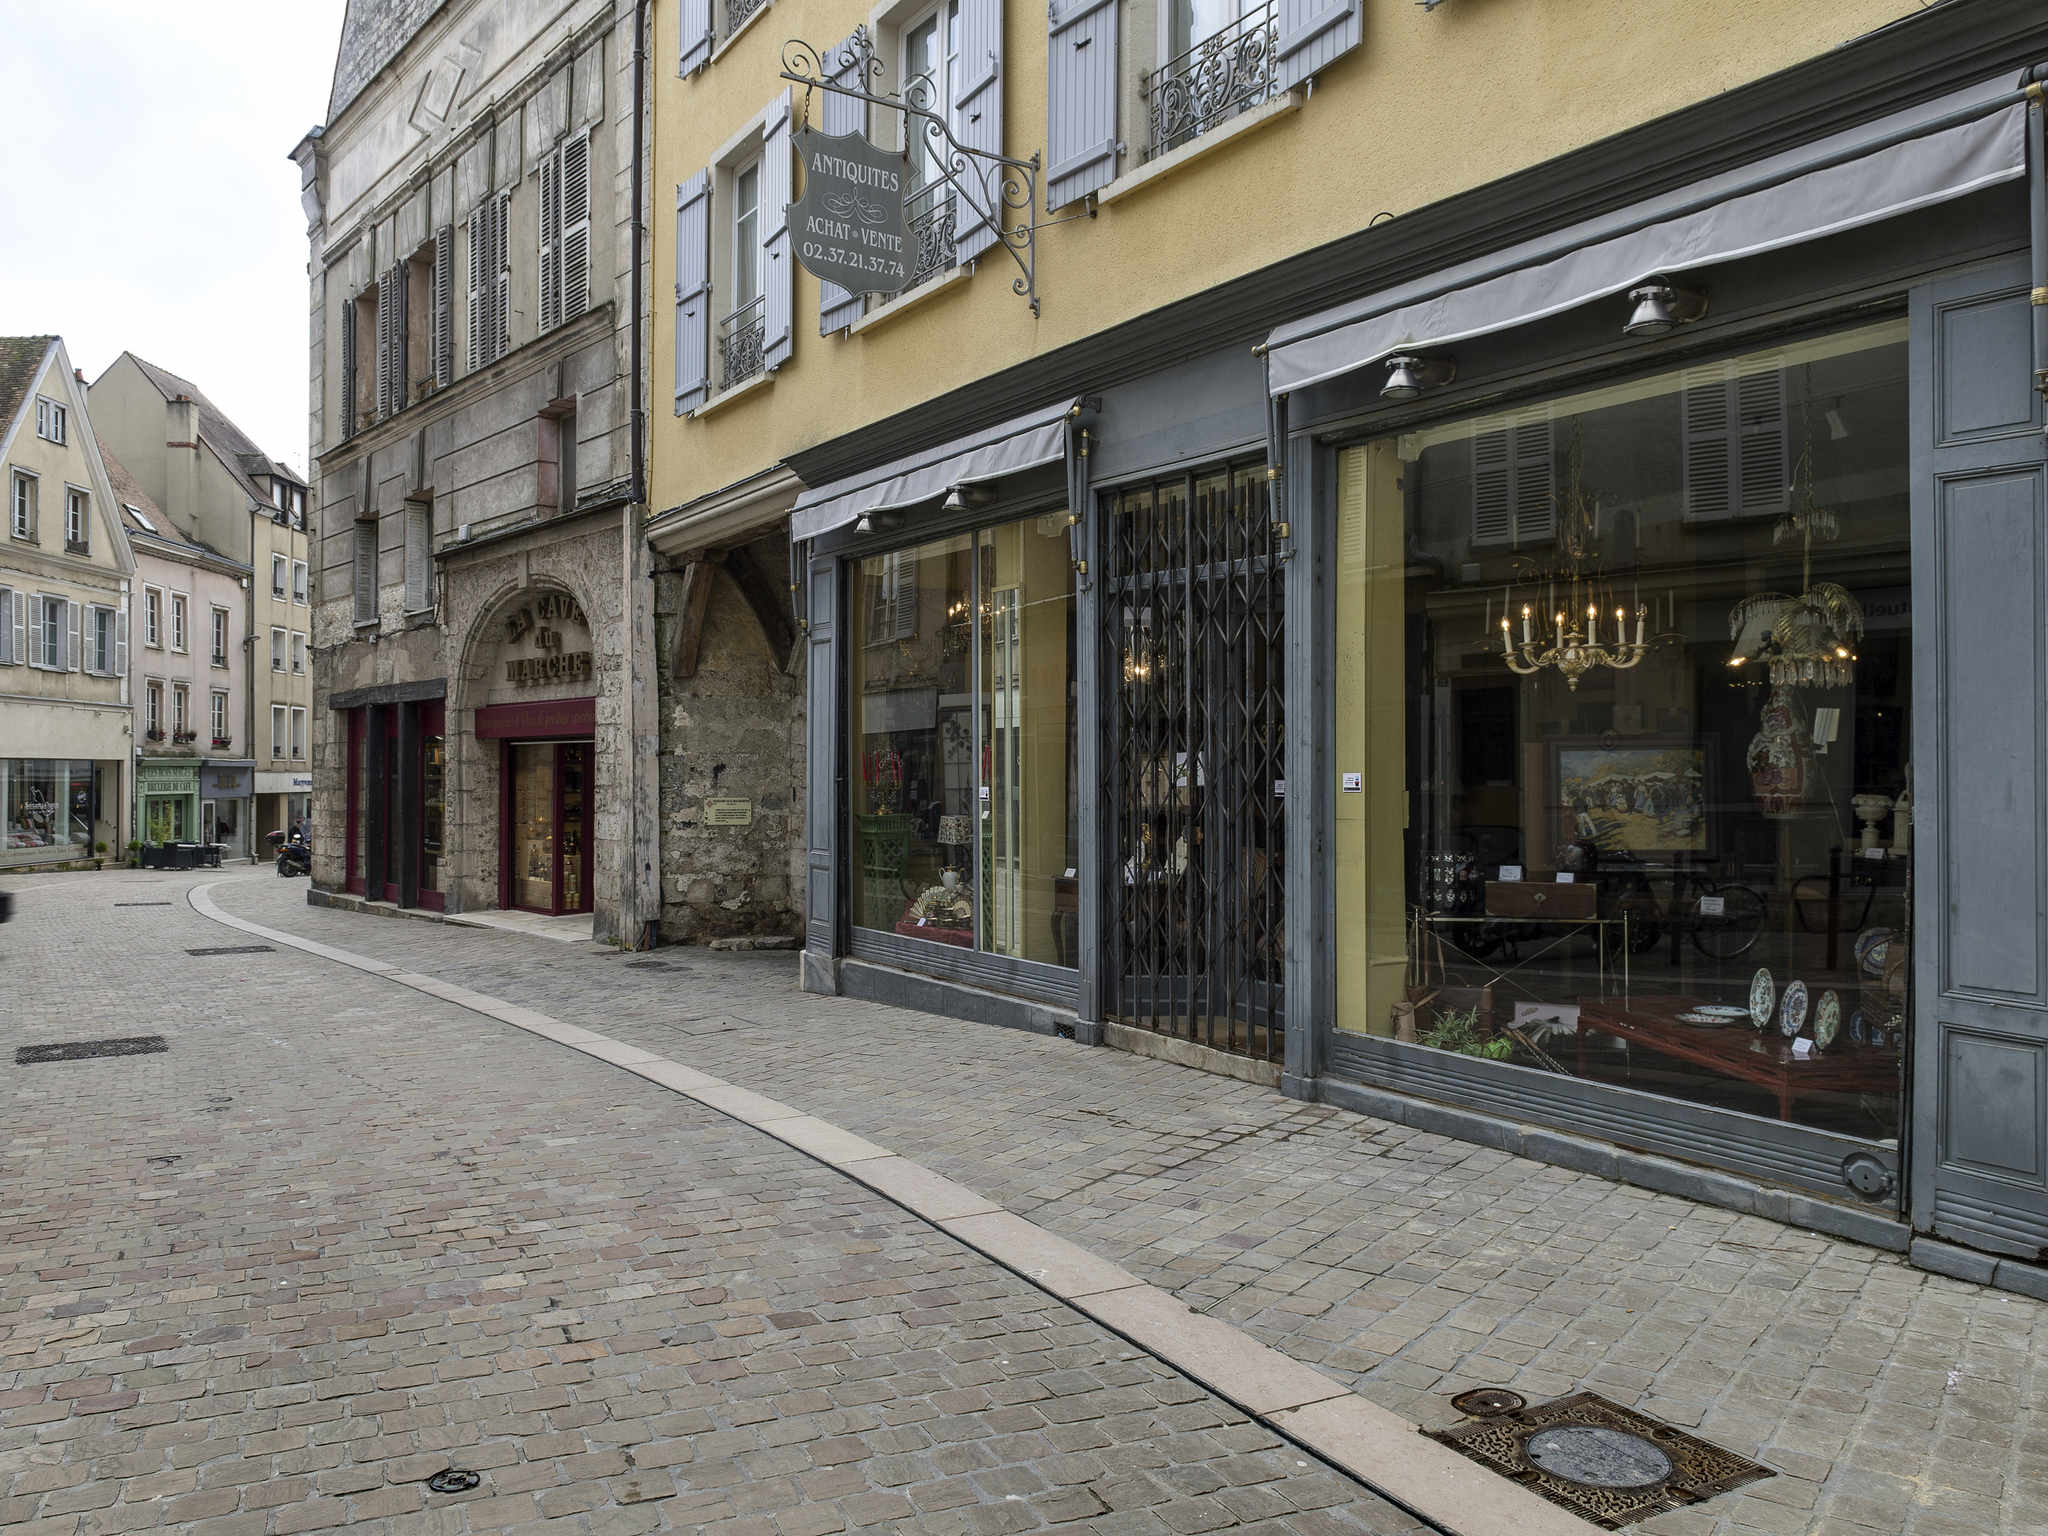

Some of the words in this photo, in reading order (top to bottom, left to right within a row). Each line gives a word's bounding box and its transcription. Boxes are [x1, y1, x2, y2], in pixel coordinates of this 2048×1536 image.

[811, 152, 899, 192] ANTIQUITES
[806, 215, 851, 240] ACHAT
[861, 227, 903, 253] VENTE
[803, 241, 905, 277] 02.37.21.37.74
[536, 595, 582, 624] CAVE
[506, 652, 583, 681] MARCHE
